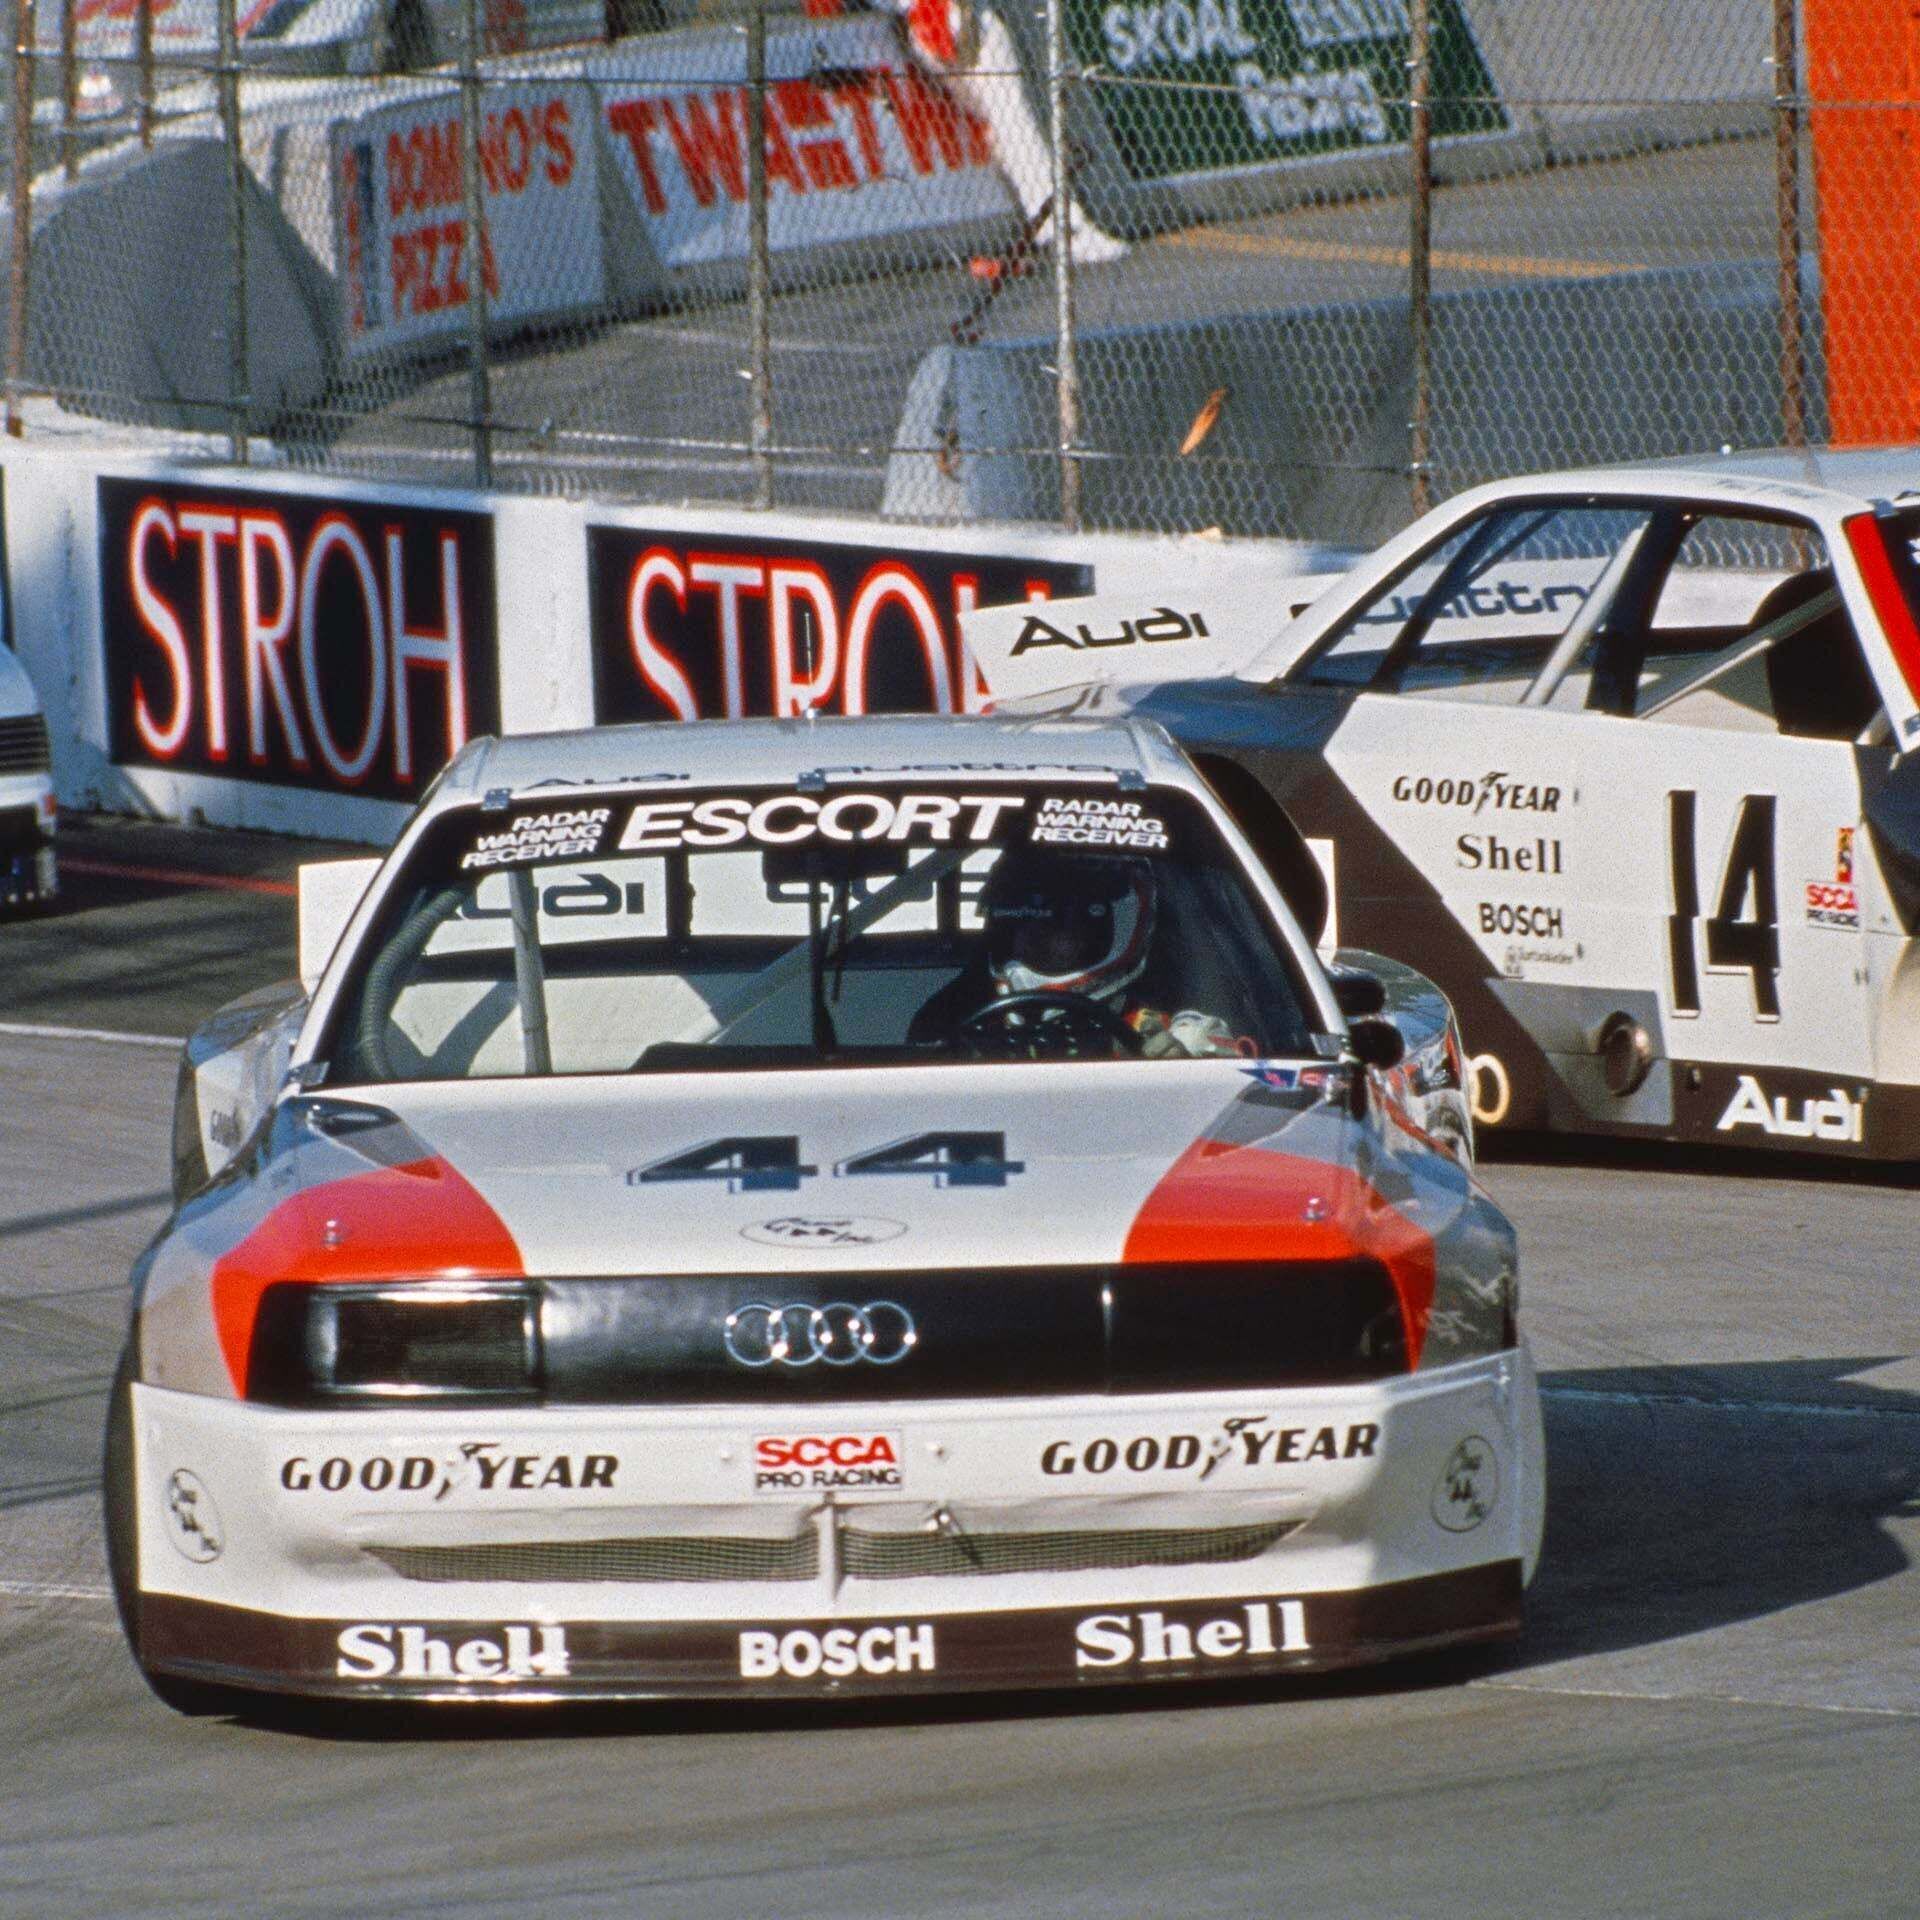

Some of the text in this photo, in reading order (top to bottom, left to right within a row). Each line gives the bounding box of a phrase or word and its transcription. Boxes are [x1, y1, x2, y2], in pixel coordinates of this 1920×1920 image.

[386, 98, 575, 220] DOMNO'S
[129, 496, 468, 784] STROH
[1010, 608, 1210, 657] Audi
[511, 808, 611, 832] RADAR
[618, 794, 1025, 850] ESCORT
[1037, 812, 1164, 834] WARNING
[1043, 798, 1141, 817] RADAR
[461, 839, 598, 869] RECEIVER
[477, 824, 603, 850] WARNING
[1031, 827, 1168, 849] RECEIVER
[1456, 833, 1562, 874] Shell
[1479, 902, 1563, 938] BOSCH
[1668, 789, 1780, 1022] 14
[1717, 1076, 1865, 1143] Audi
[627, 1131, 1026, 1193] 44
[757, 1437, 896, 1467] SCCA
[756, 1468, 902, 1488] PRO RACING
[336, 1623, 570, 1678] Shell
[739, 1625, 935, 1678] BOSCH
[1075, 1601, 1311, 1668] Shell
